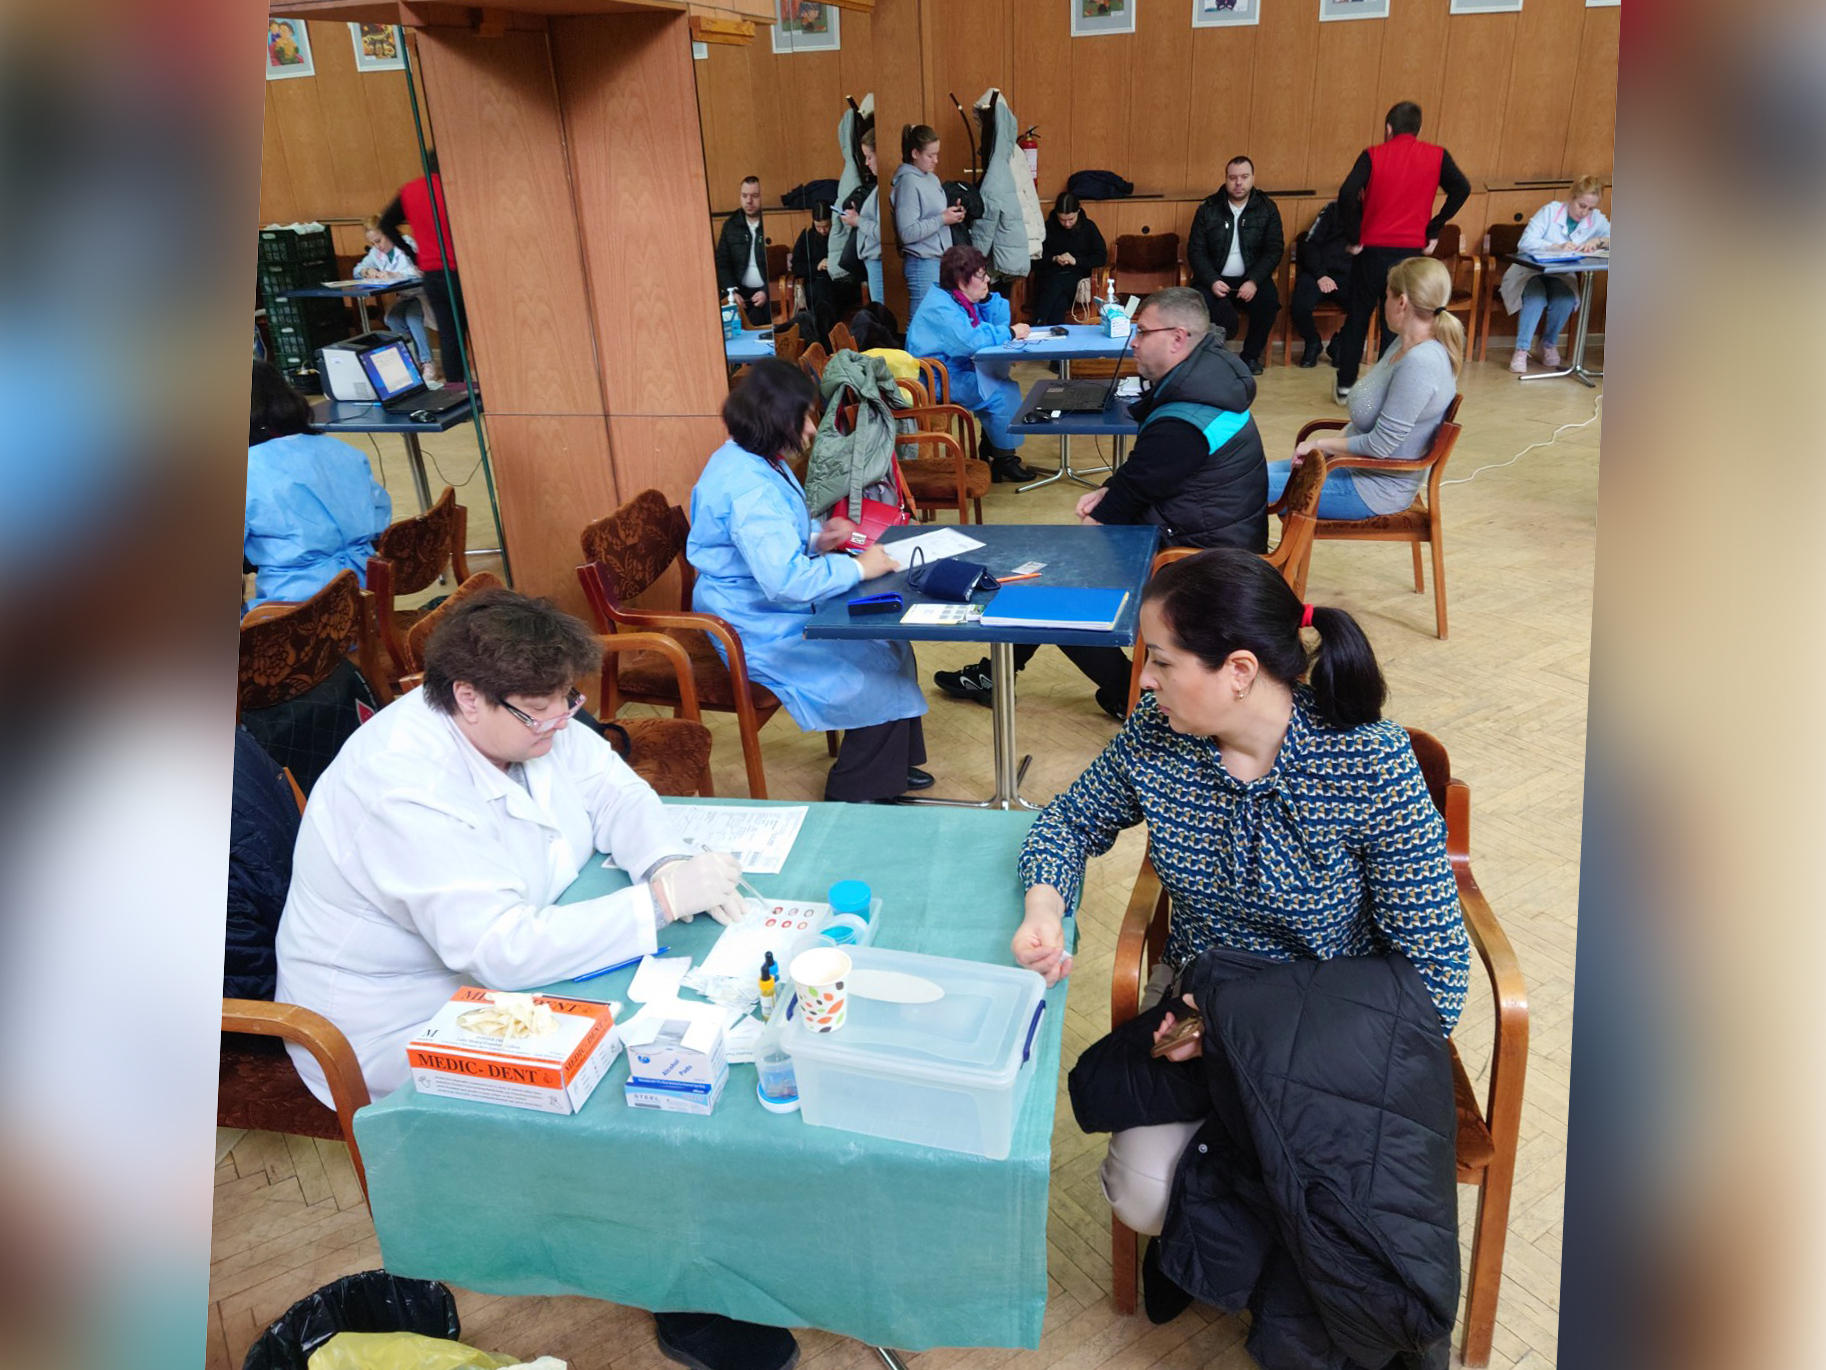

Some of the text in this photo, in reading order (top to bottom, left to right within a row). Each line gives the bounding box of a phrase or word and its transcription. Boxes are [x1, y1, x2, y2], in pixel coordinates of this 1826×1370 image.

[488, 1064, 538, 1084] DENT
[661, 1057, 680, 1076] Alcohol
[678, 1064, 693, 1076] Pads
[633, 1093, 659, 1102] STEEL
